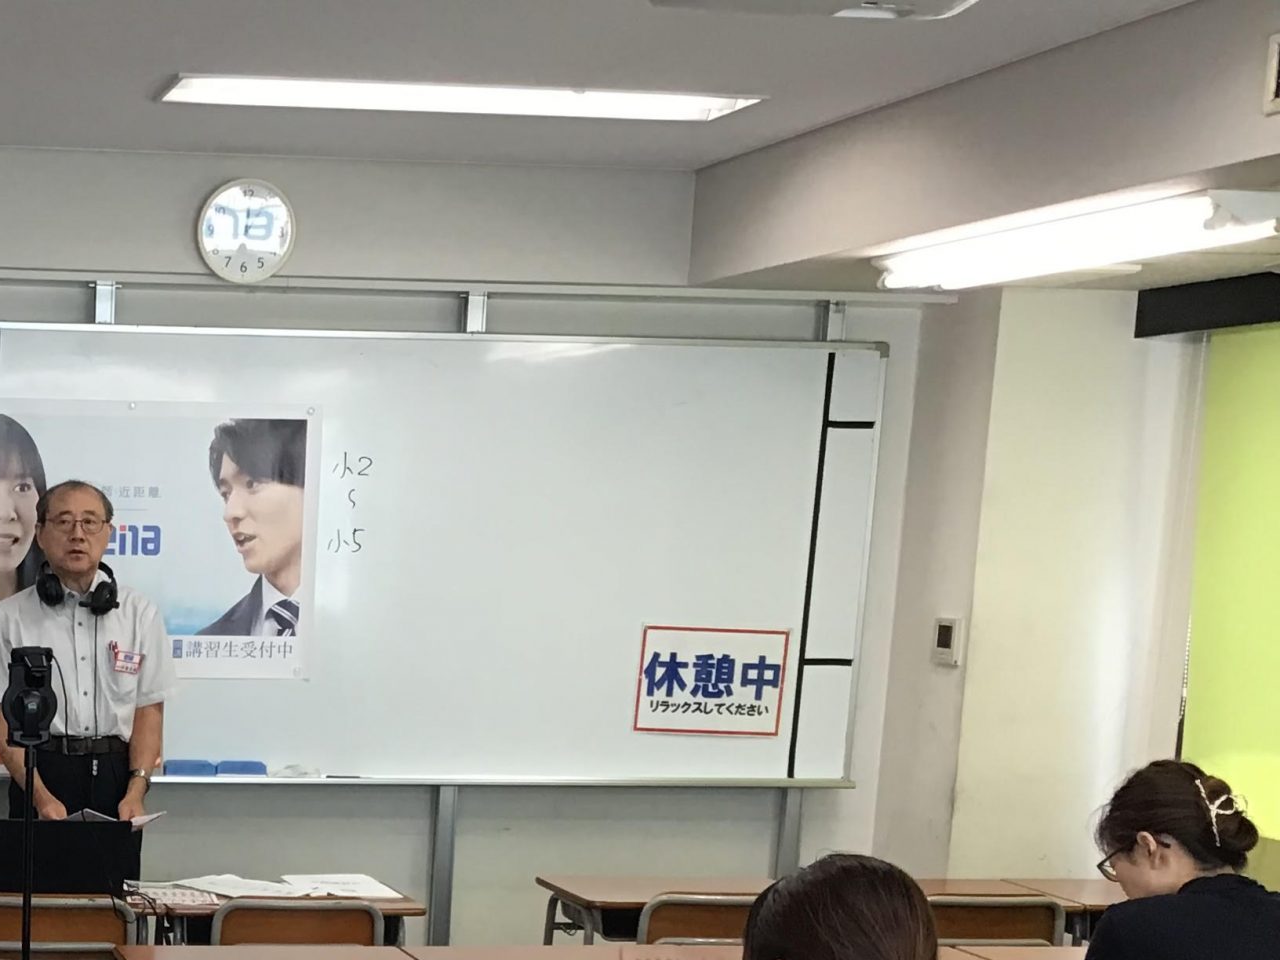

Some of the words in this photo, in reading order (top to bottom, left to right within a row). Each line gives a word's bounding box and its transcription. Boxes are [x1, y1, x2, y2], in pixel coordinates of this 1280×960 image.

[224, 256, 232, 268] 7
[240, 261, 248, 273] 6
[257, 257, 265, 269] 5
[332, 451, 373, 479] 小2
[327, 528, 366, 553] 小5
[185, 640, 293, 659] 講習生受付中
[644, 651, 781, 701] 休憩中
[649, 700, 769, 717] リラックスしてください
